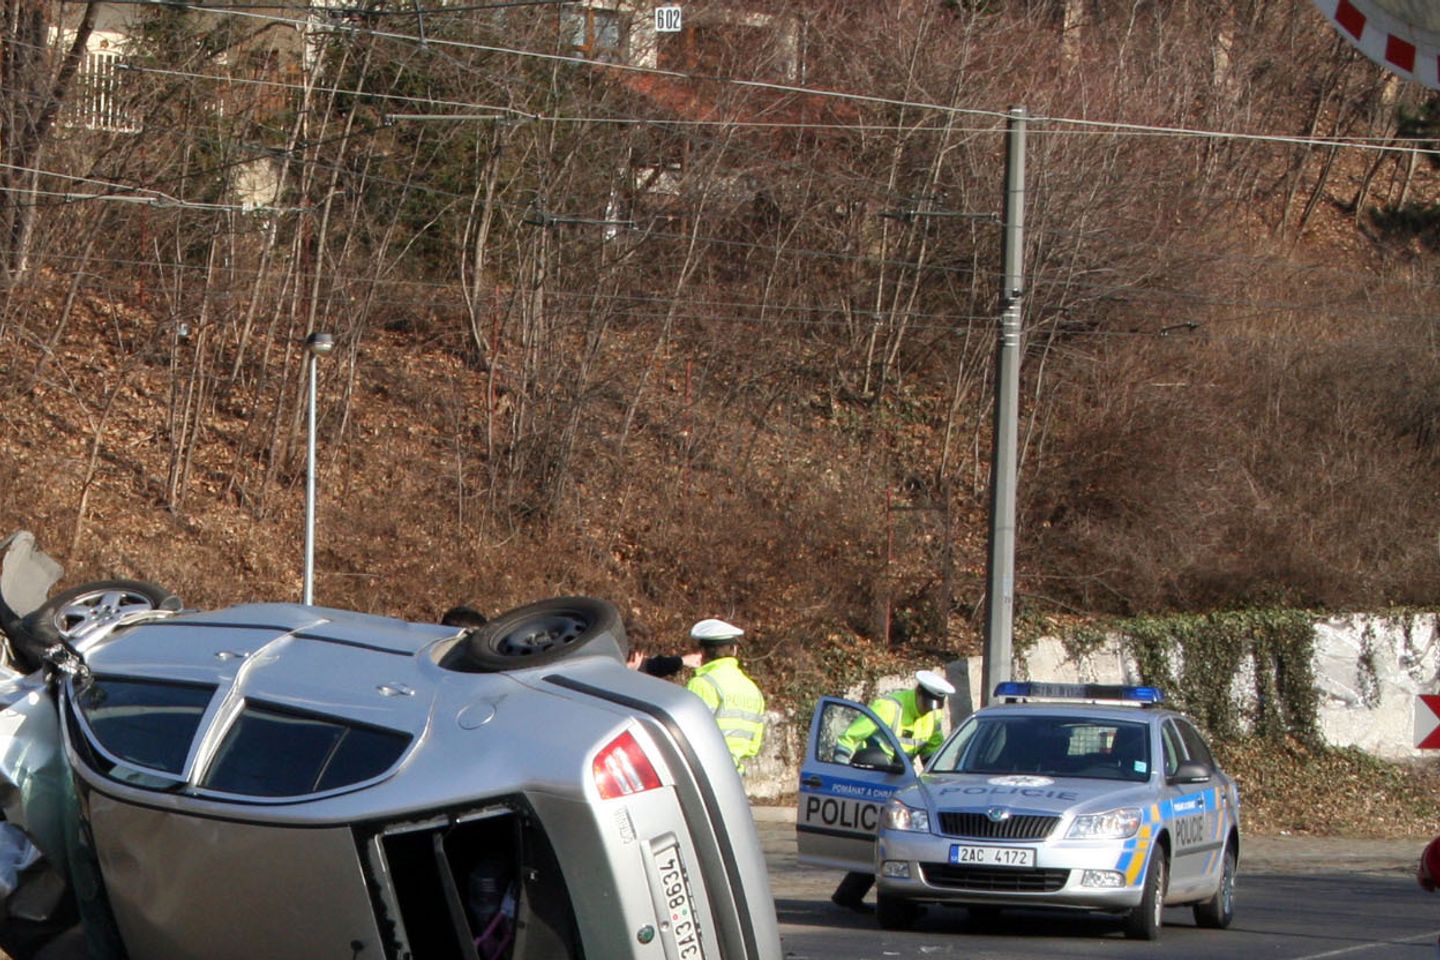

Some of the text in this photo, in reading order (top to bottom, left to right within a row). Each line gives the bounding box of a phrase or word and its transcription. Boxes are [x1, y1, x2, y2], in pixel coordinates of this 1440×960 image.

[656, 8, 680, 29] 602
[940, 786, 1079, 801] POLICIE
[806, 796, 885, 831] POLIC
[1175, 815, 1203, 846] POLICIE
[962, 848, 1027, 864] 2AC 4172
[659, 858, 698, 960] 3A3 8634
